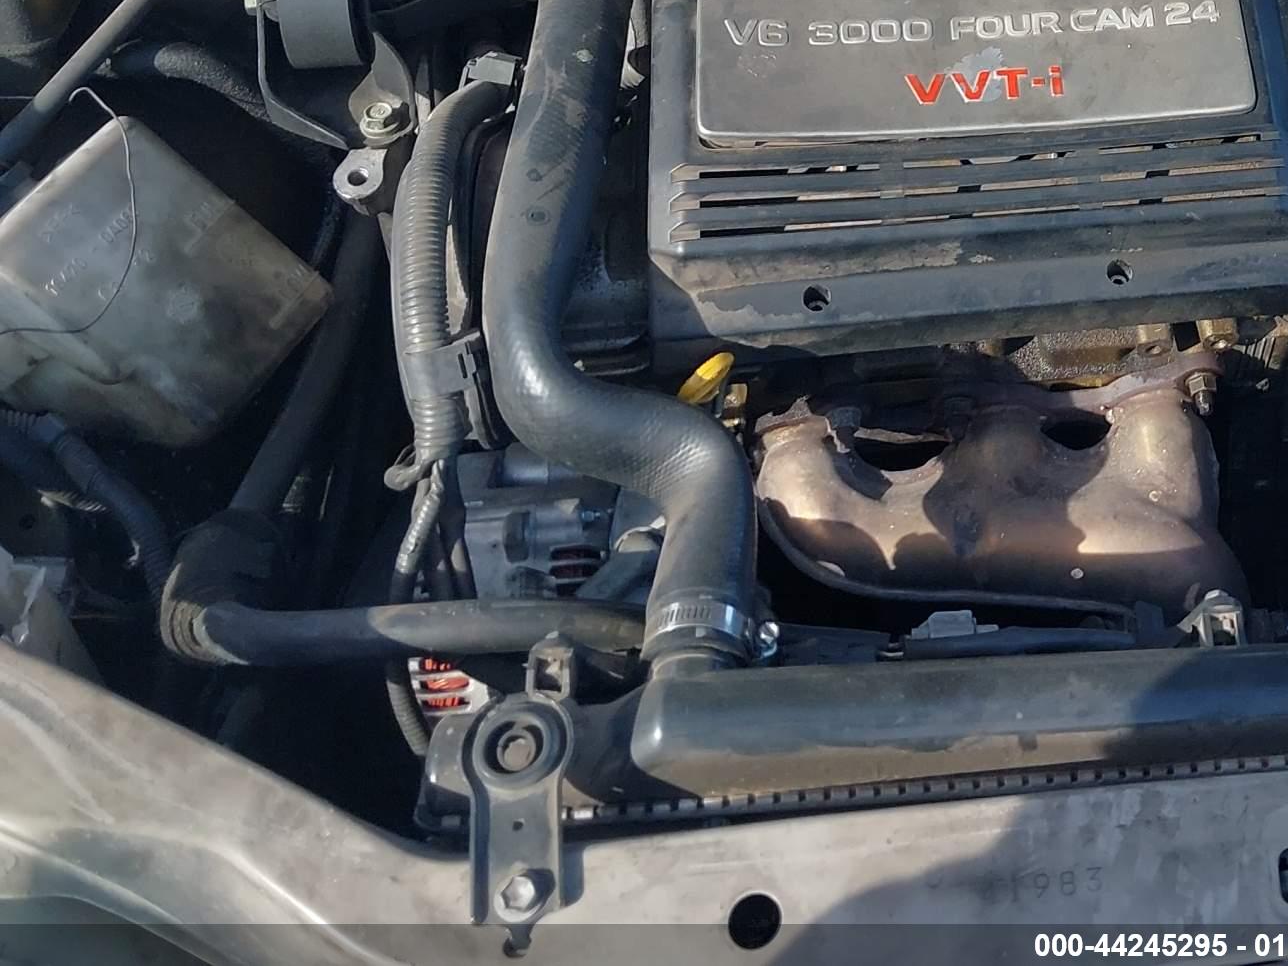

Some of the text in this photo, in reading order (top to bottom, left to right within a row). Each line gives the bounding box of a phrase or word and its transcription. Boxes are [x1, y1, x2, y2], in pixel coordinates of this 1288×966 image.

[723, 0, 1220, 47] V6 3000 FOUR CAM 24
[904, 65, 1064, 105] VVT-i
